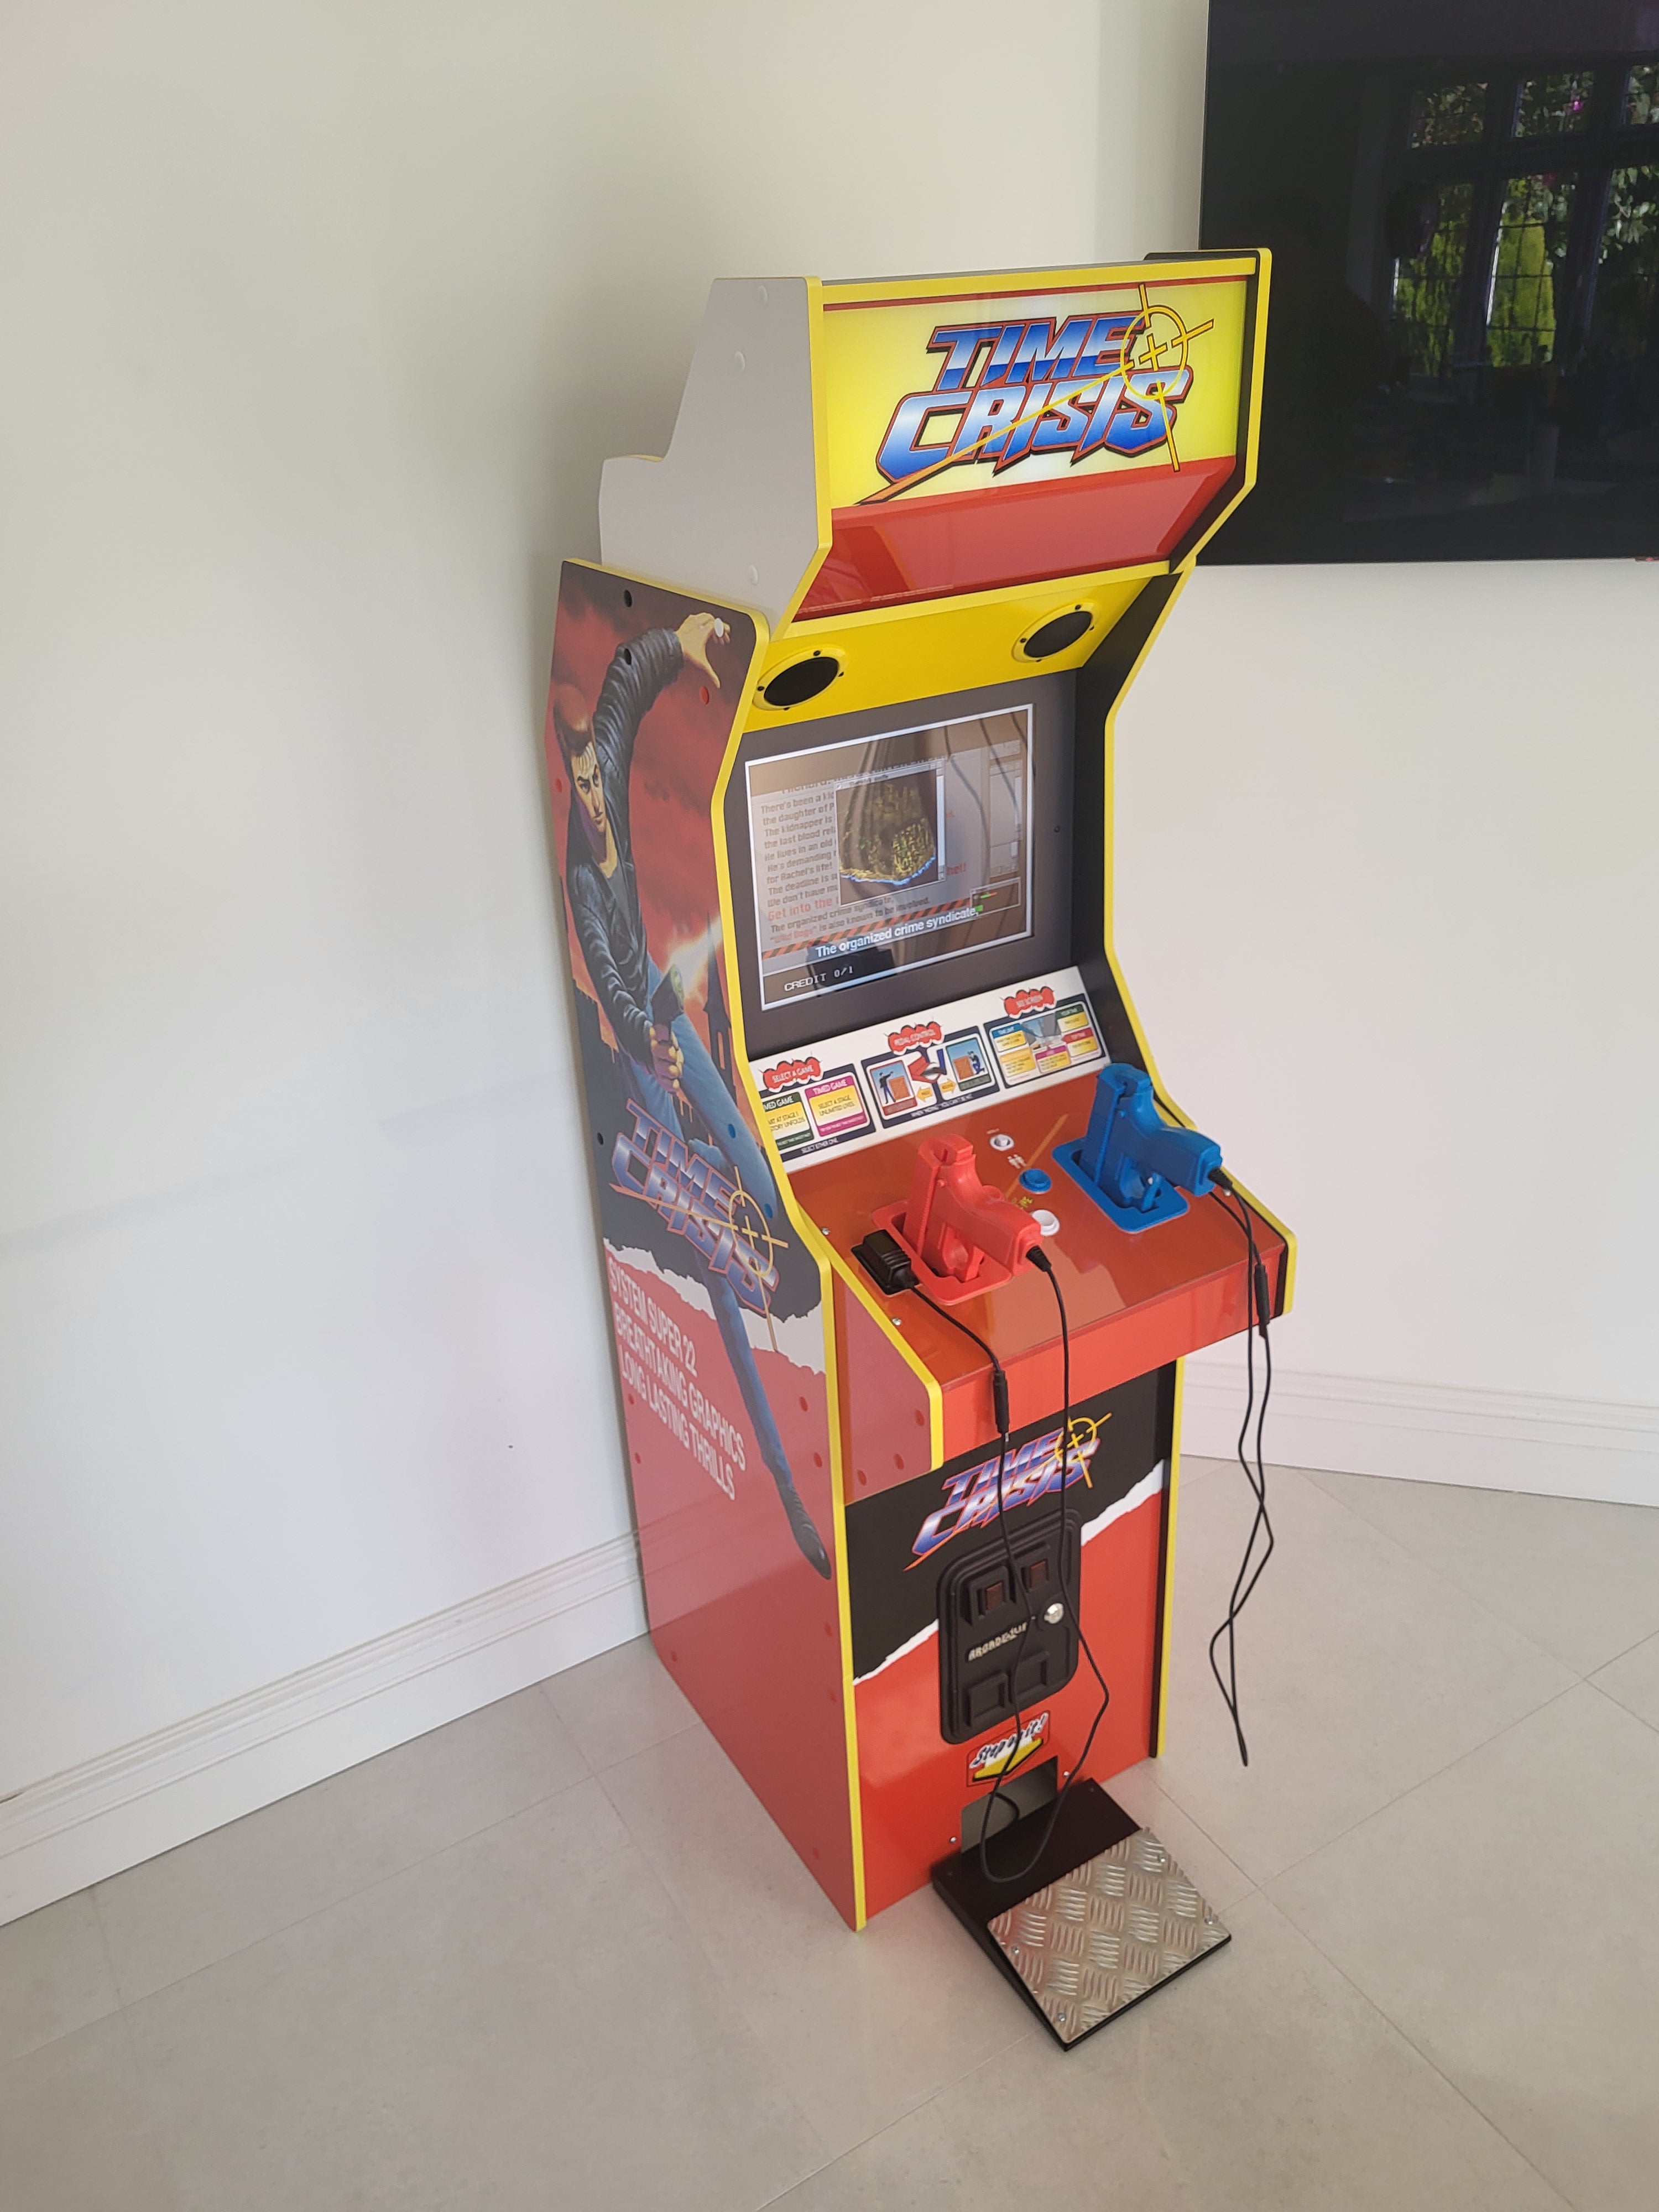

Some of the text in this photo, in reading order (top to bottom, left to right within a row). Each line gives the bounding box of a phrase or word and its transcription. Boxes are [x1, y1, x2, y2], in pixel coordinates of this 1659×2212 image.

[926, 310, 1149, 390] TIME
[875, 366, 1194, 484] CRISIS
[761, 802, 791, 814] There's
[793, 797, 813, 807] been
[763, 817, 777, 826] the
[779, 808, 816, 821] daughter
[818, 804, 828, 813] of
[765, 828, 779, 837] The
[781, 817, 823, 833] kidnapper
[764, 841, 778, 849] the
[798, 830, 821, 842] blood
[786, 851, 832, 868] demanding
[766, 876, 779, 884] for
[768, 887, 783, 895] The
[805, 887, 826, 899] have
[768, 908, 786, 921] Get
[790, 903, 811, 916] into
[814, 898, 833, 909] the
[771, 924, 785, 933] The
[787, 913, 828, 929] organized
[815, 906, 979, 957] The organized crime syndicate,
[784, 966, 853, 992] CREDIT 0/1
[797, 1065, 813, 1075] GAME
[831, 1080, 847, 1089] GAME
[777, 1096, 794, 1107] GAME
[626, 1098, 743, 1223] TIME
[612, 1132, 780, 1314] CRISIS
[609, 1256, 698, 1378] SYSTEM SUPER 22
[613, 1301, 746, 1472] BREATHTAKING GRAPHICS
[618, 1344, 735, 1501] LONG LASTING THRILLS
[942, 1427, 1065, 1505] TIME
[912, 1437, 1102, 1556] CRISIS
